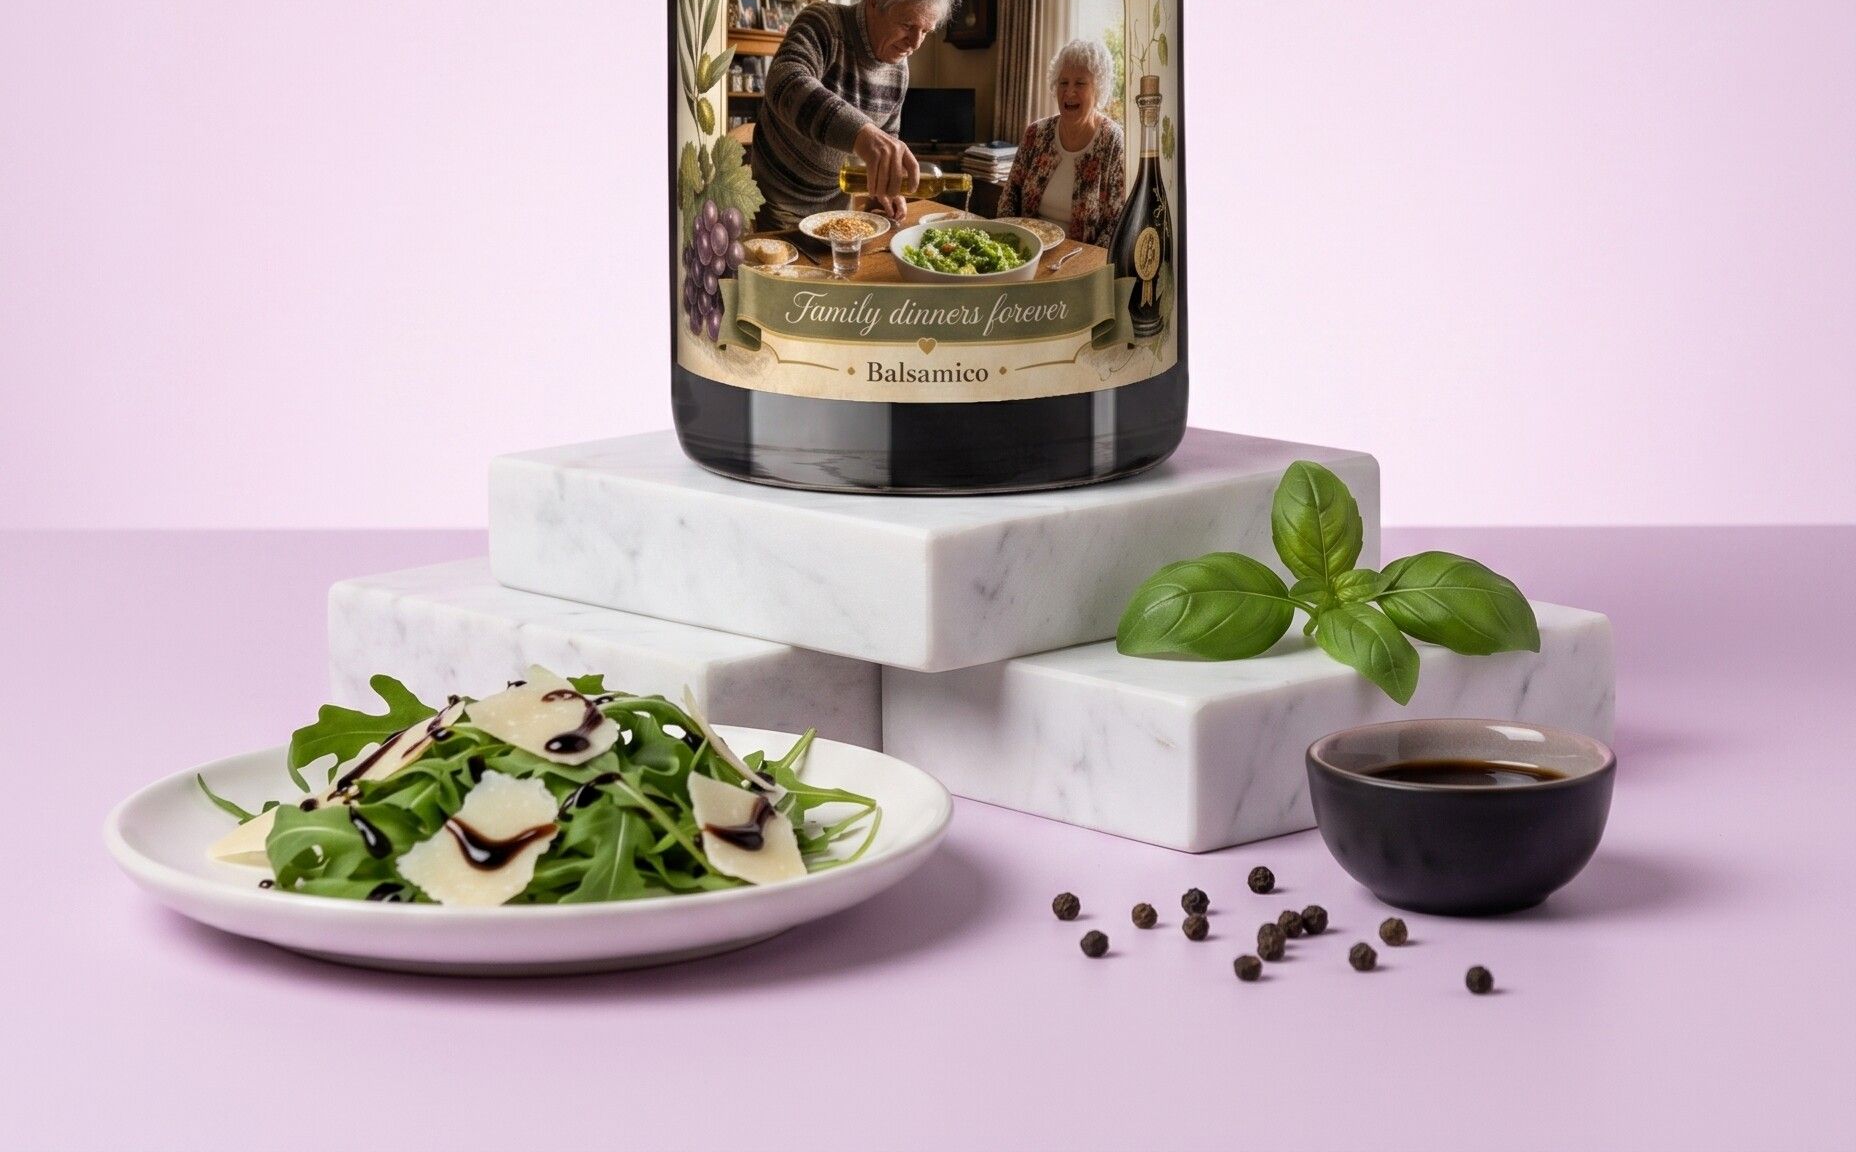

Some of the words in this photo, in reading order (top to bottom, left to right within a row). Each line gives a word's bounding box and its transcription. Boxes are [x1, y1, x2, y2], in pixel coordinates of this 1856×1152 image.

[785, 291, 881, 336] Family
[889, 298, 983, 325] dinners
[984, 294, 1069, 335] forever
[867, 361, 989, 383] Balsamico
